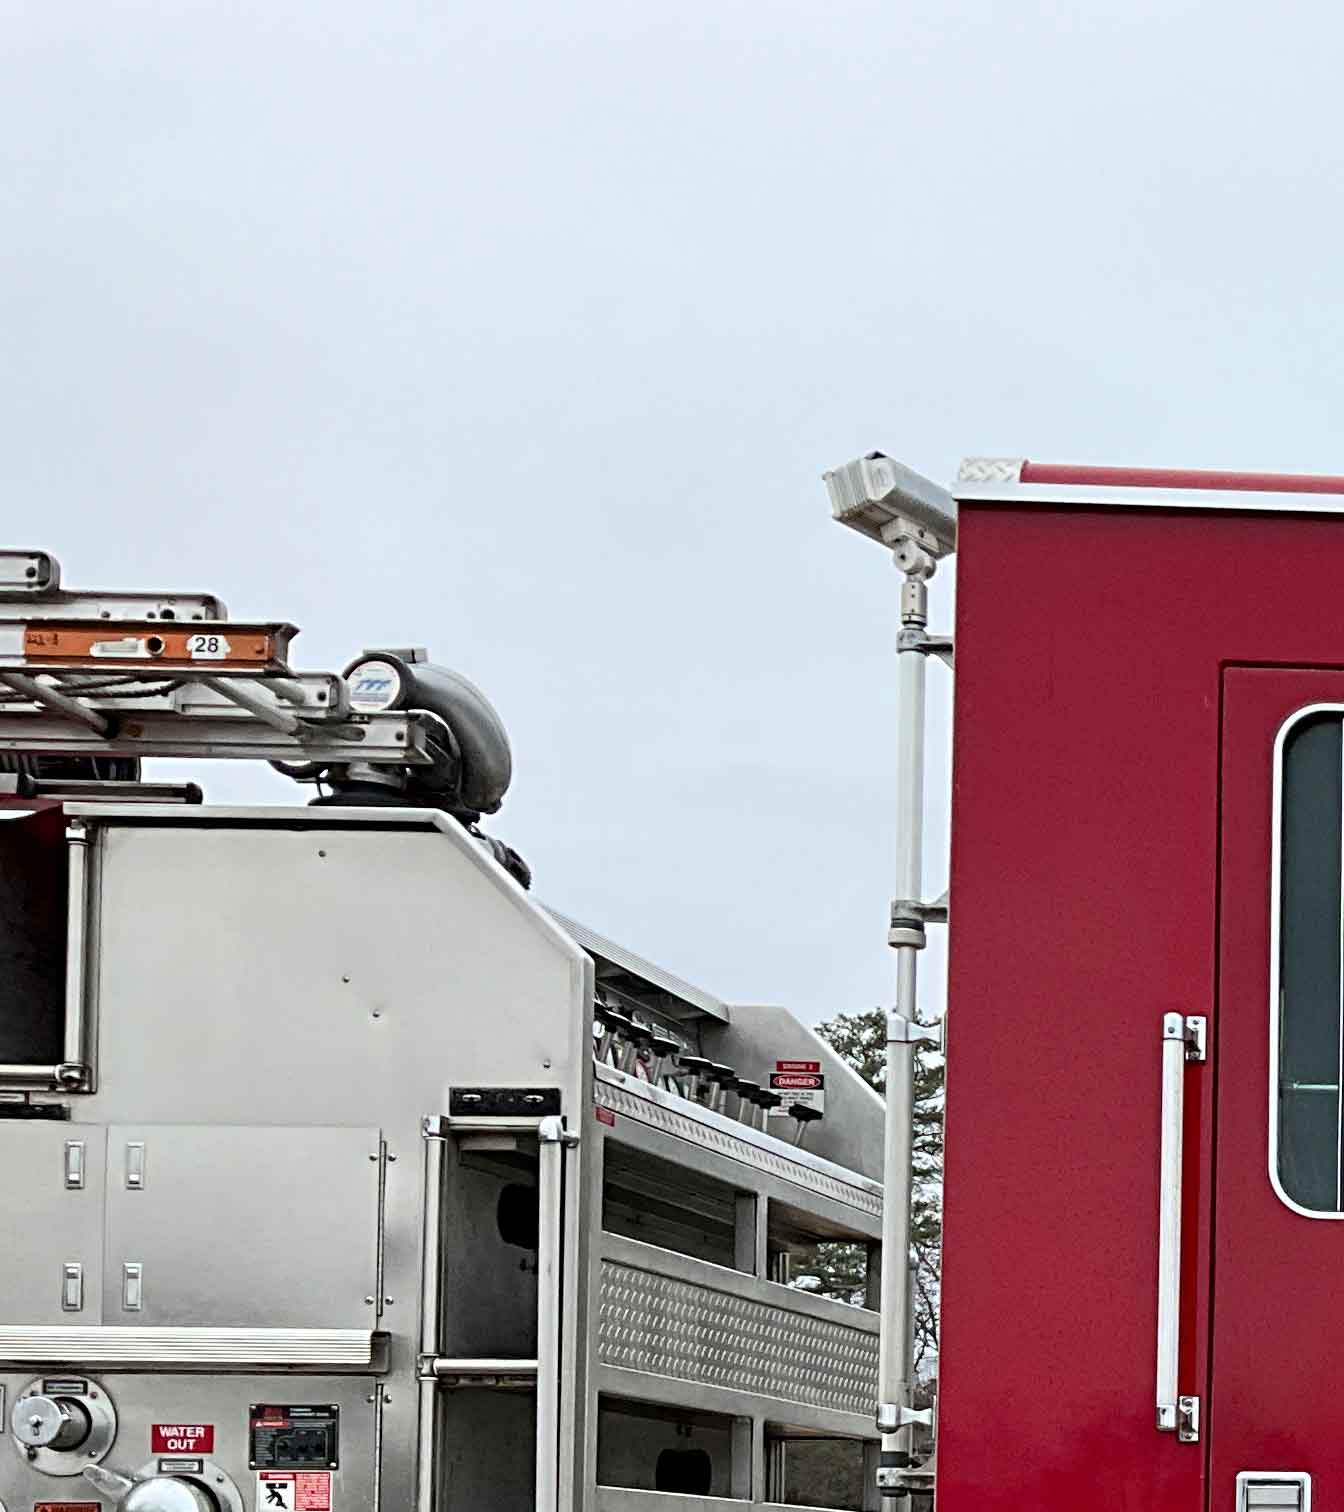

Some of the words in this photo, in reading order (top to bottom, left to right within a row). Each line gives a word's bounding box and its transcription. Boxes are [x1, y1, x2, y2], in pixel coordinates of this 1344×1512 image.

[195, 637, 219, 653] 28
[779, 1077, 816, 1086] DANGER
[159, 1426, 205, 1438] WATER
[167, 1438, 197, 1450] OUT
